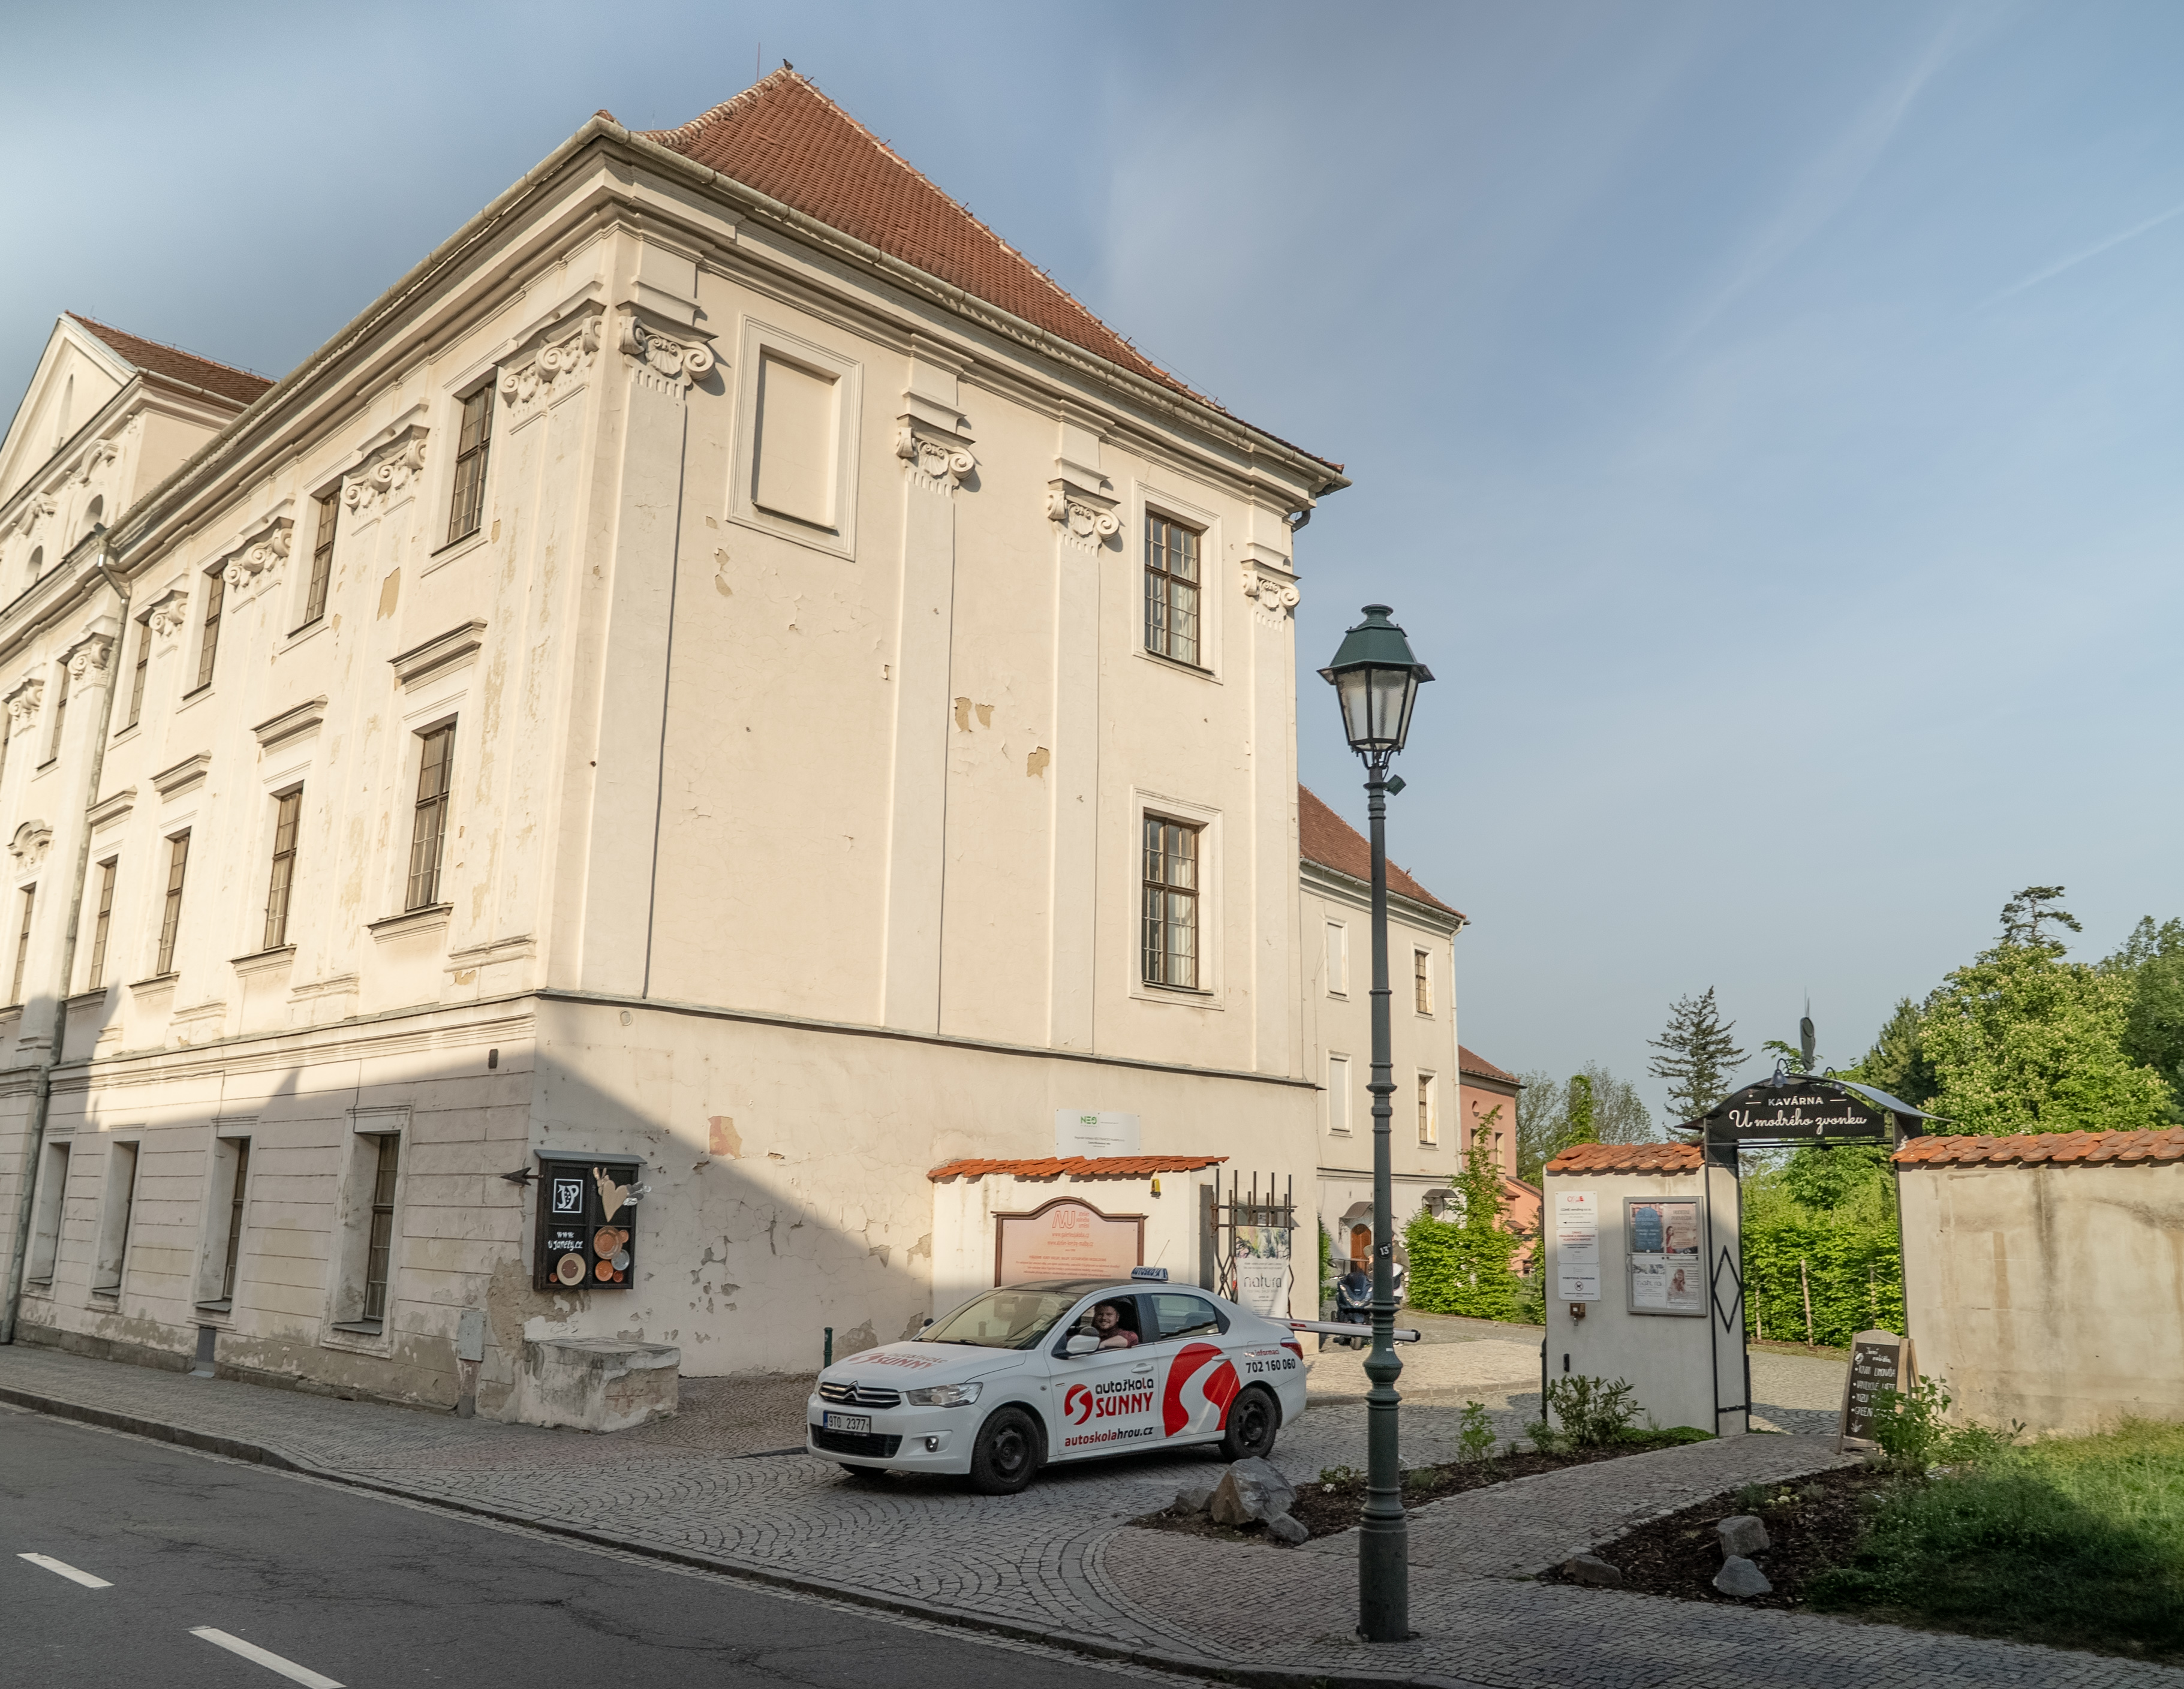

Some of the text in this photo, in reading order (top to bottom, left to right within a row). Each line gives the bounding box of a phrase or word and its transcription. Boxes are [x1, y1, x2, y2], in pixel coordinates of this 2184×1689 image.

[1768, 1096, 1824, 1106] KAVÁRNA
[1729, 1107, 1867, 1135] U modrého zvonku
[1244, 1273, 1282, 1288] natura
[870, 1356, 936, 1370] SUNNY
[1246, 1358, 1296, 1373] 702 160 060
[1096, 1377, 1154, 1394] autoškola
[1096, 1392, 1154, 1418] SUNNY
[846, 1417, 866, 1431] 2377
[1064, 1426, 1154, 1447] autoskolahrou.cz
